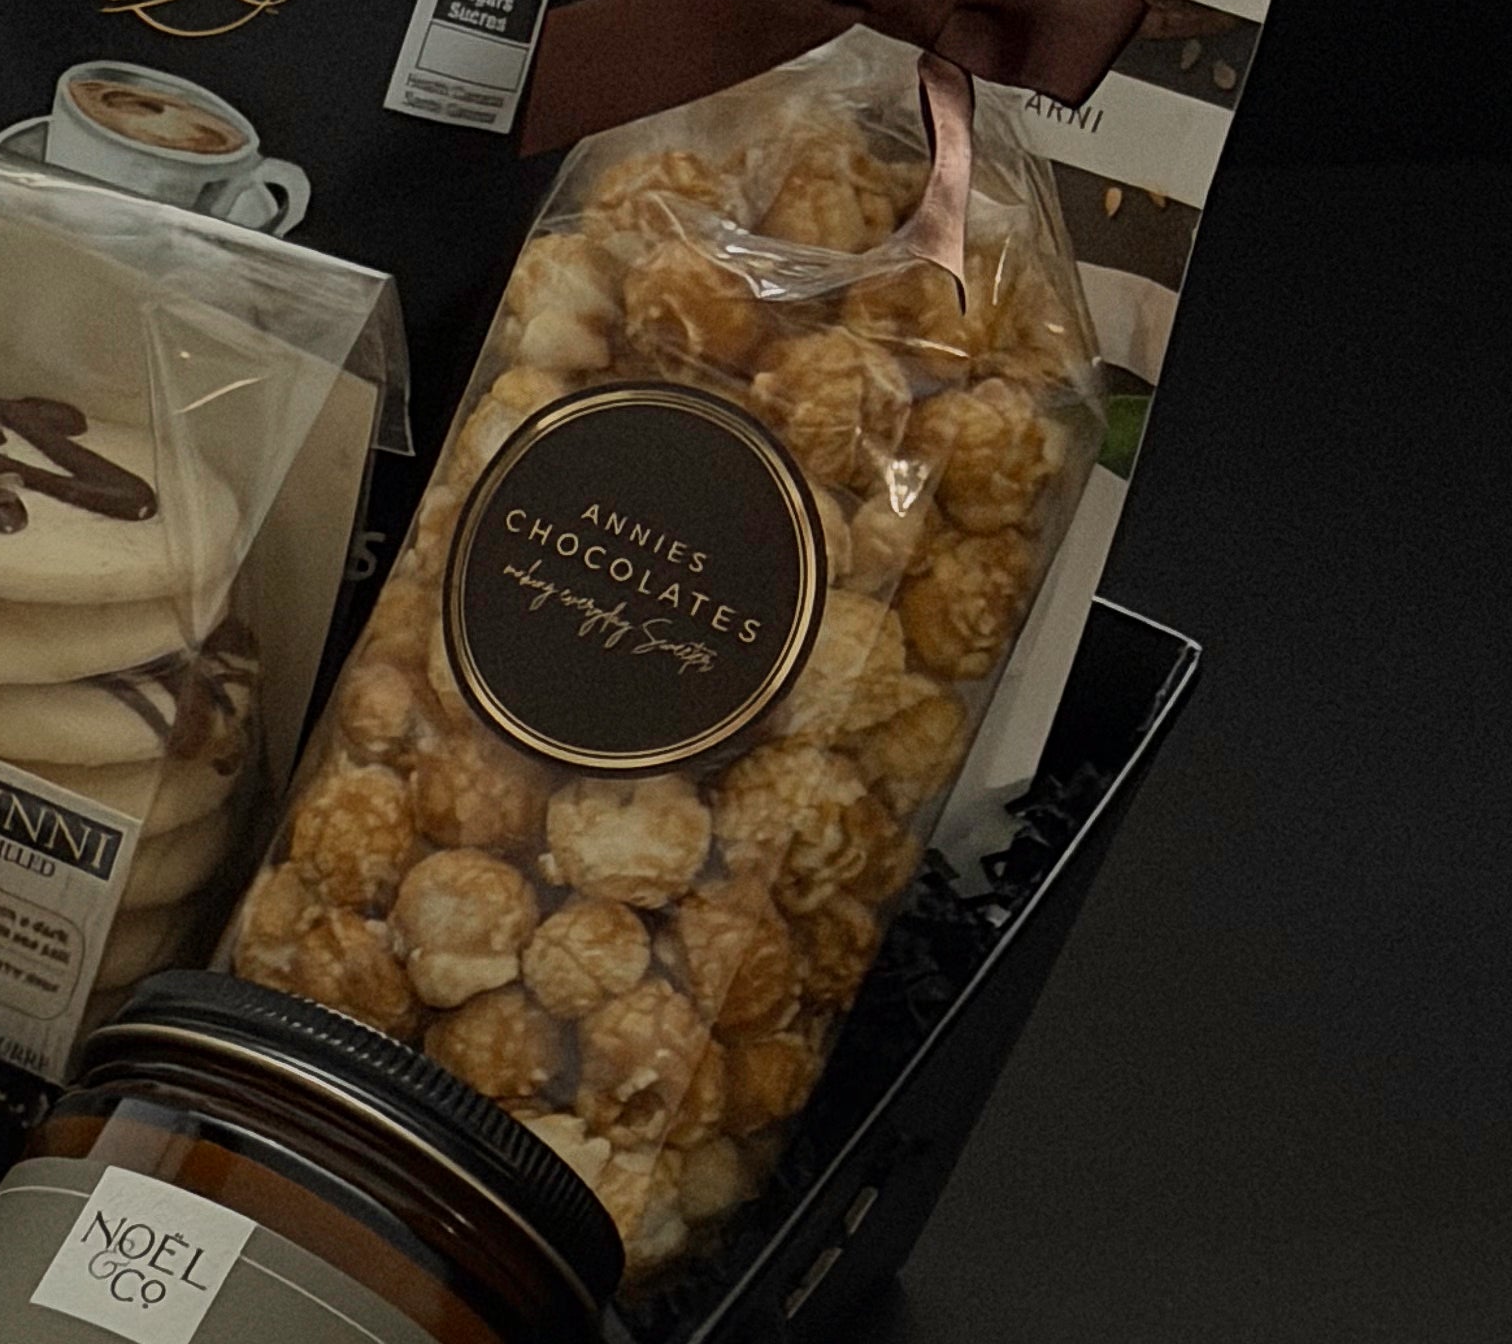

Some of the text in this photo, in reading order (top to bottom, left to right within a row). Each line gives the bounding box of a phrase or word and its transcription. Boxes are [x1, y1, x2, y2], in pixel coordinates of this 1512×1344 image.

[1024, 91, 1104, 133] ARNI
[505, 509, 762, 644] CHOCOLATES
[580, 503, 708, 574] ANNIES
[80, 1210, 207, 1291] NOËL
